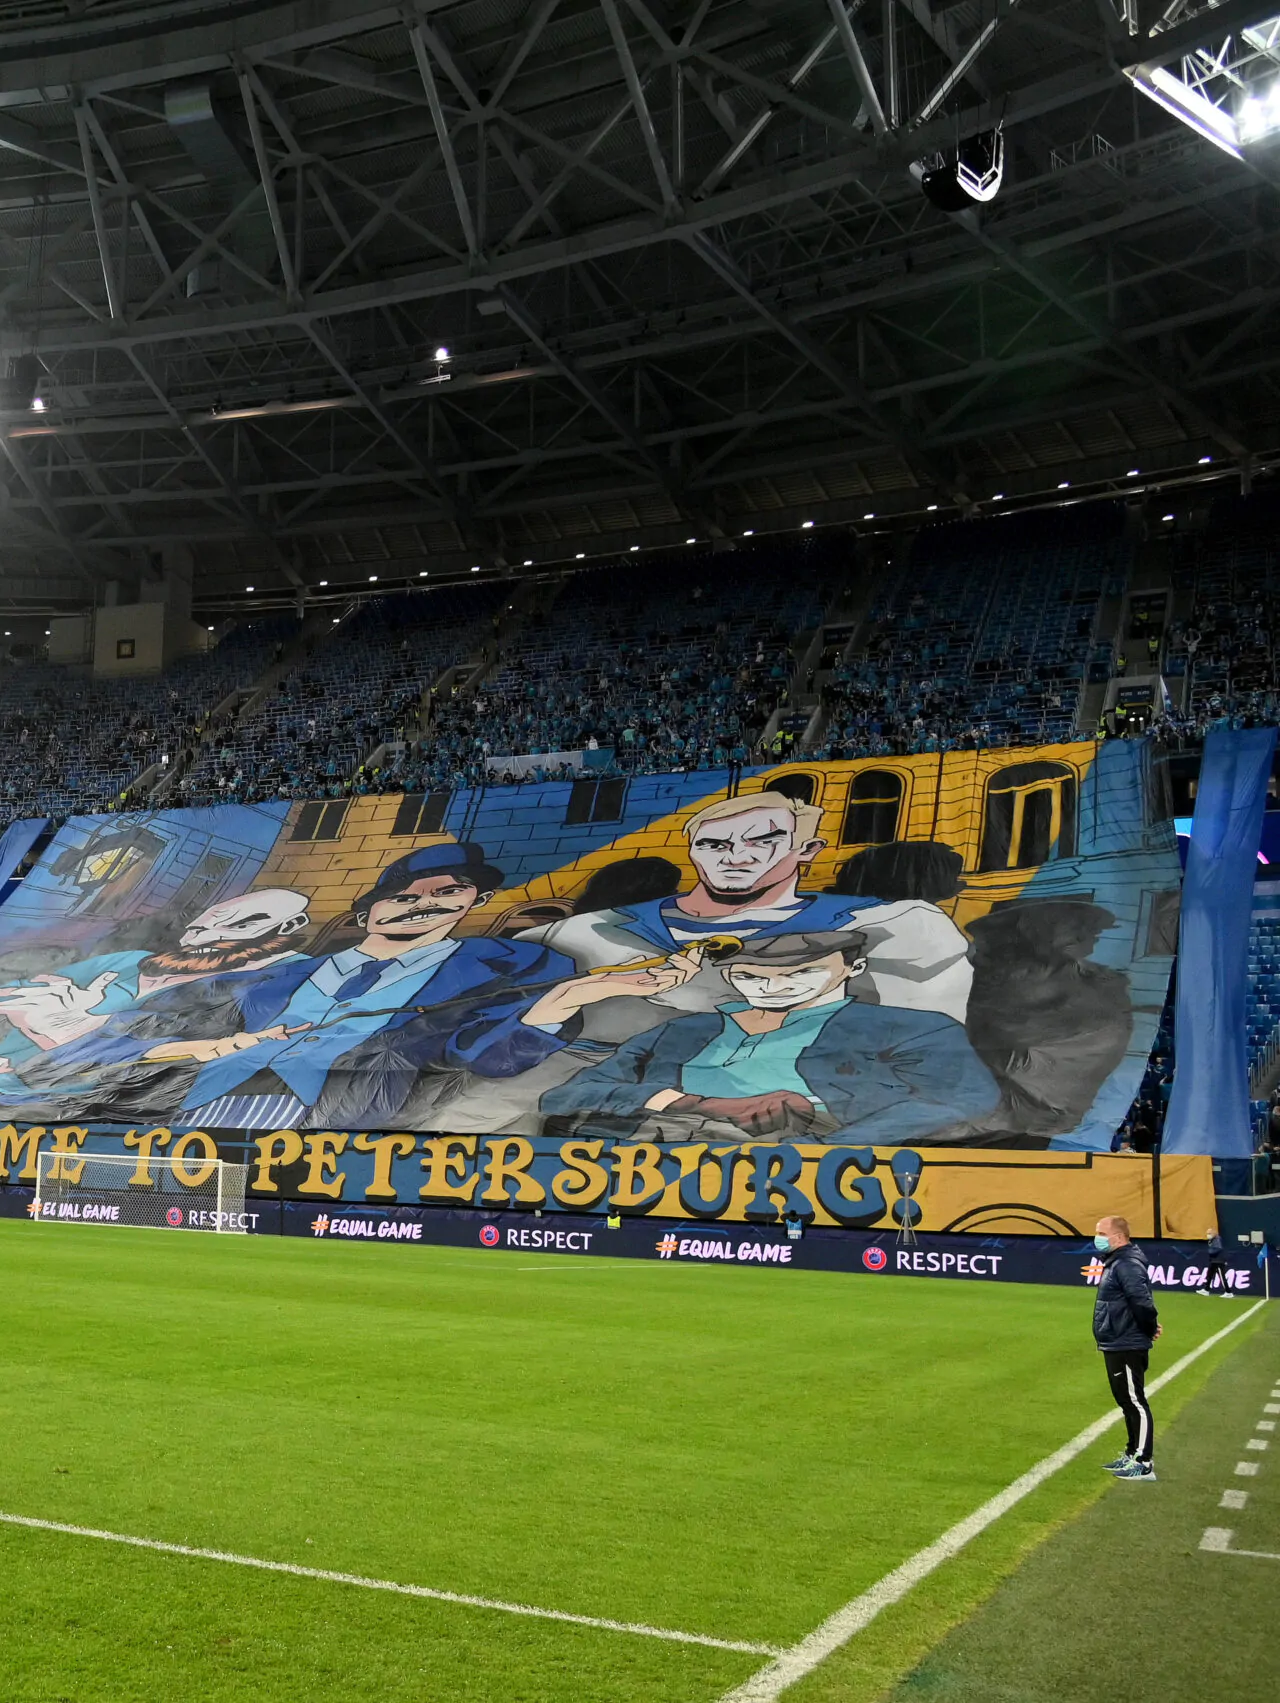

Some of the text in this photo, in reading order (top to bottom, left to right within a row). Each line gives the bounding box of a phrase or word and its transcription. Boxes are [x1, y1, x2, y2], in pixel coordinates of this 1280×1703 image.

[123, 1127, 219, 1188] TO
[251, 1129, 923, 1222] PETERSBURG!
[82, 1203, 120, 1220] GAME
[189, 1209, 260, 1229] RESPECT
[311, 1214, 423, 1240] #EQUAL GAME
[507, 1228, 593, 1250] RESPECT
[655, 1234, 793, 1263] #EQUAL GAME
[896, 1251, 1003, 1275] RESPECT
